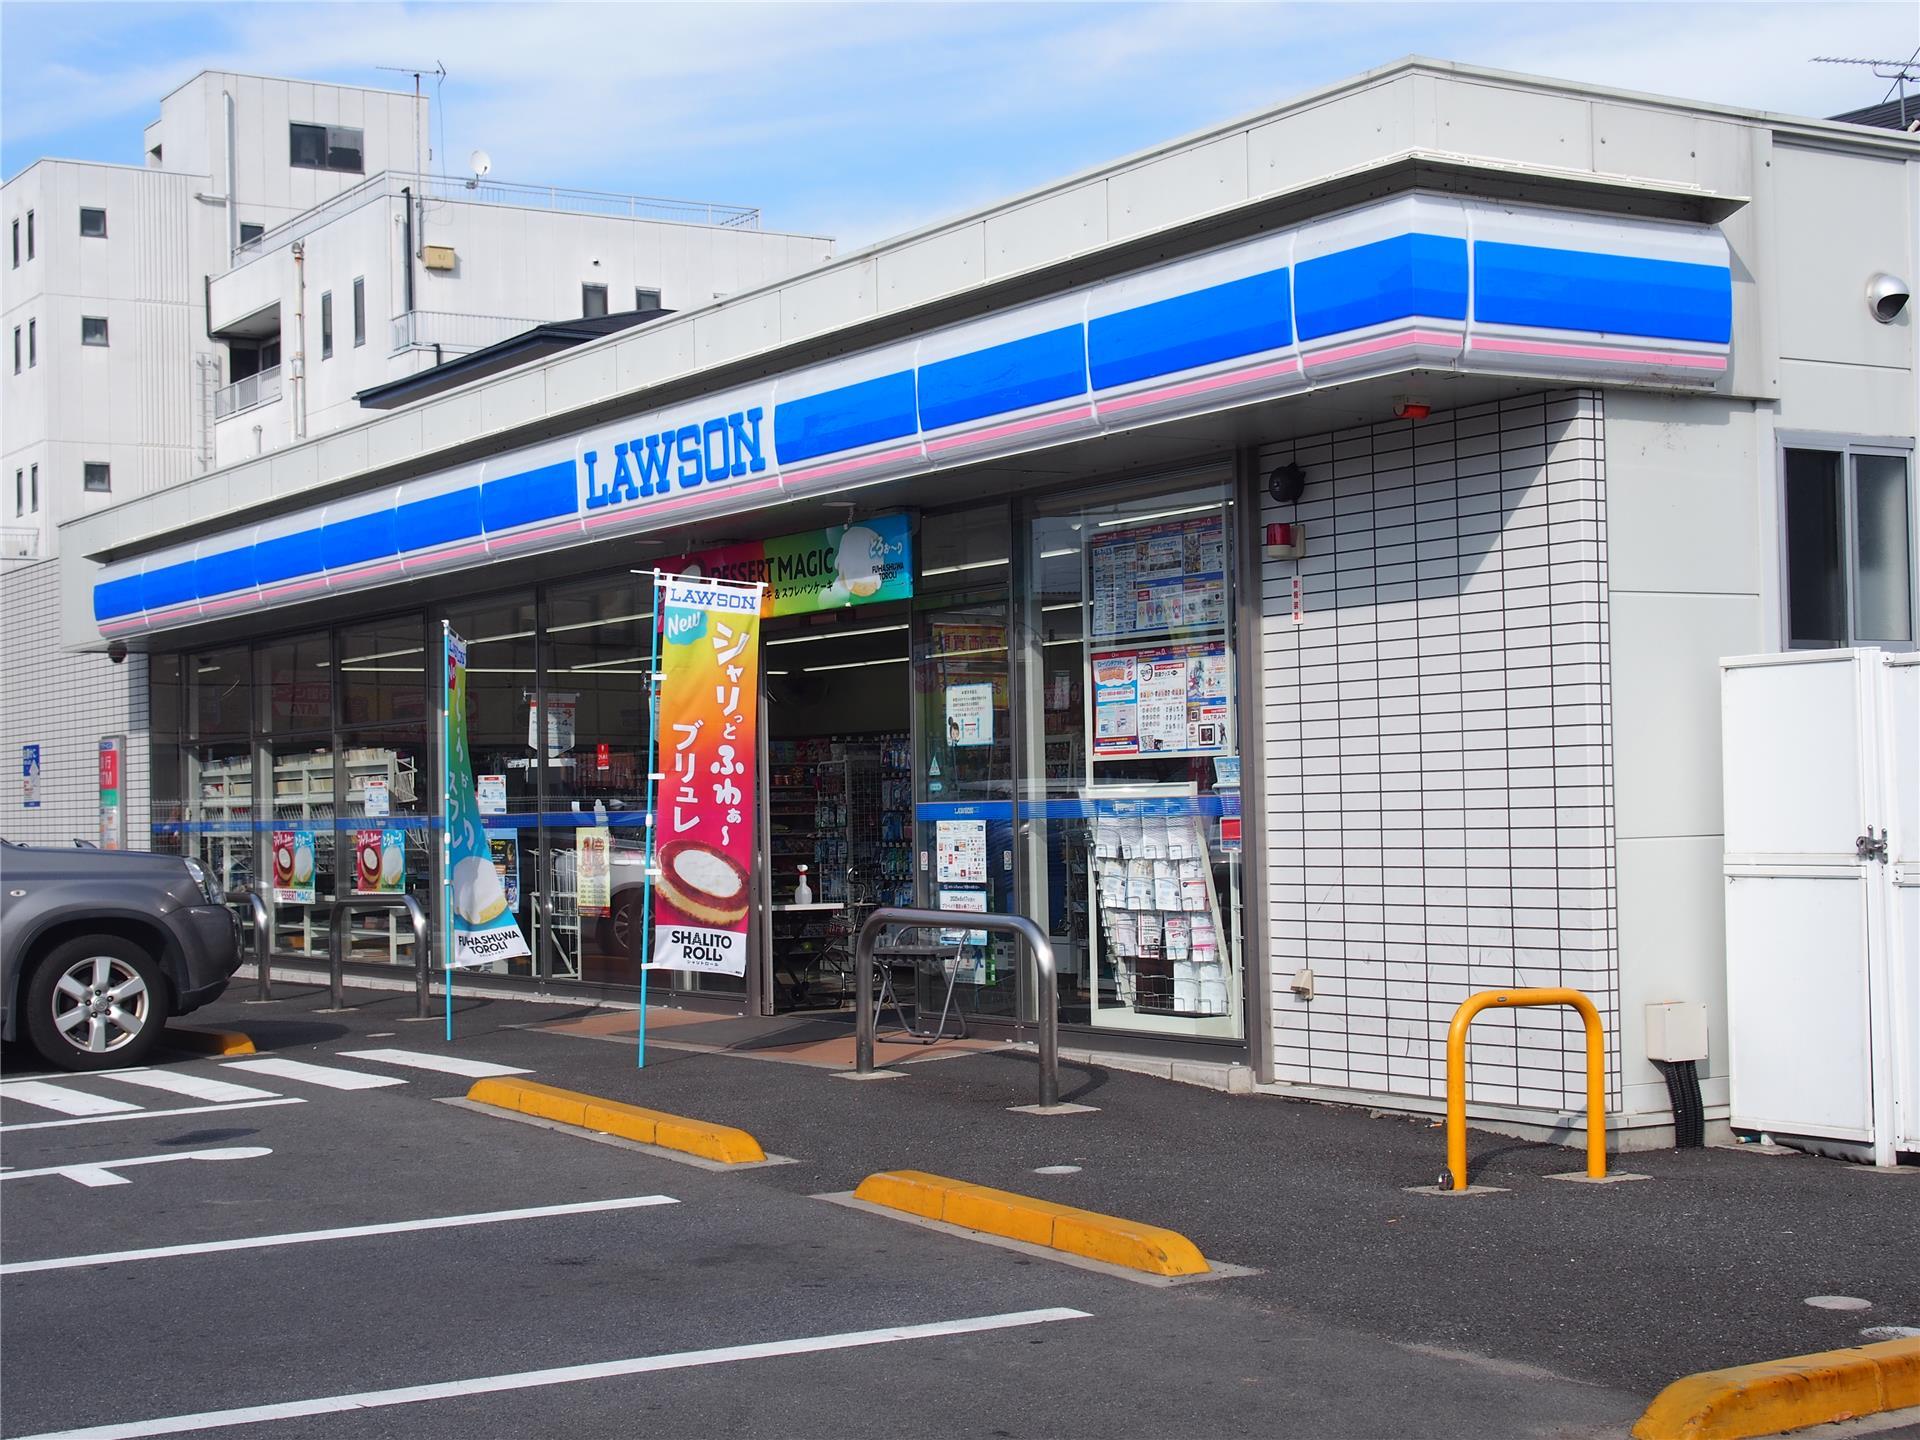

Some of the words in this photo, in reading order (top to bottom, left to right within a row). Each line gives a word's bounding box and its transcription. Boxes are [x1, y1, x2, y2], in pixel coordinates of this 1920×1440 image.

[583, 406, 766, 509] LAWSON
[777, 547, 834, 582] MAGIC
[670, 588, 756, 610] LAWSON
[667, 611, 701, 638] New
[672, 719, 704, 833] ブリュレ
[469, 939, 508, 955] TOROLI
[671, 930, 732, 949] SHALITO
